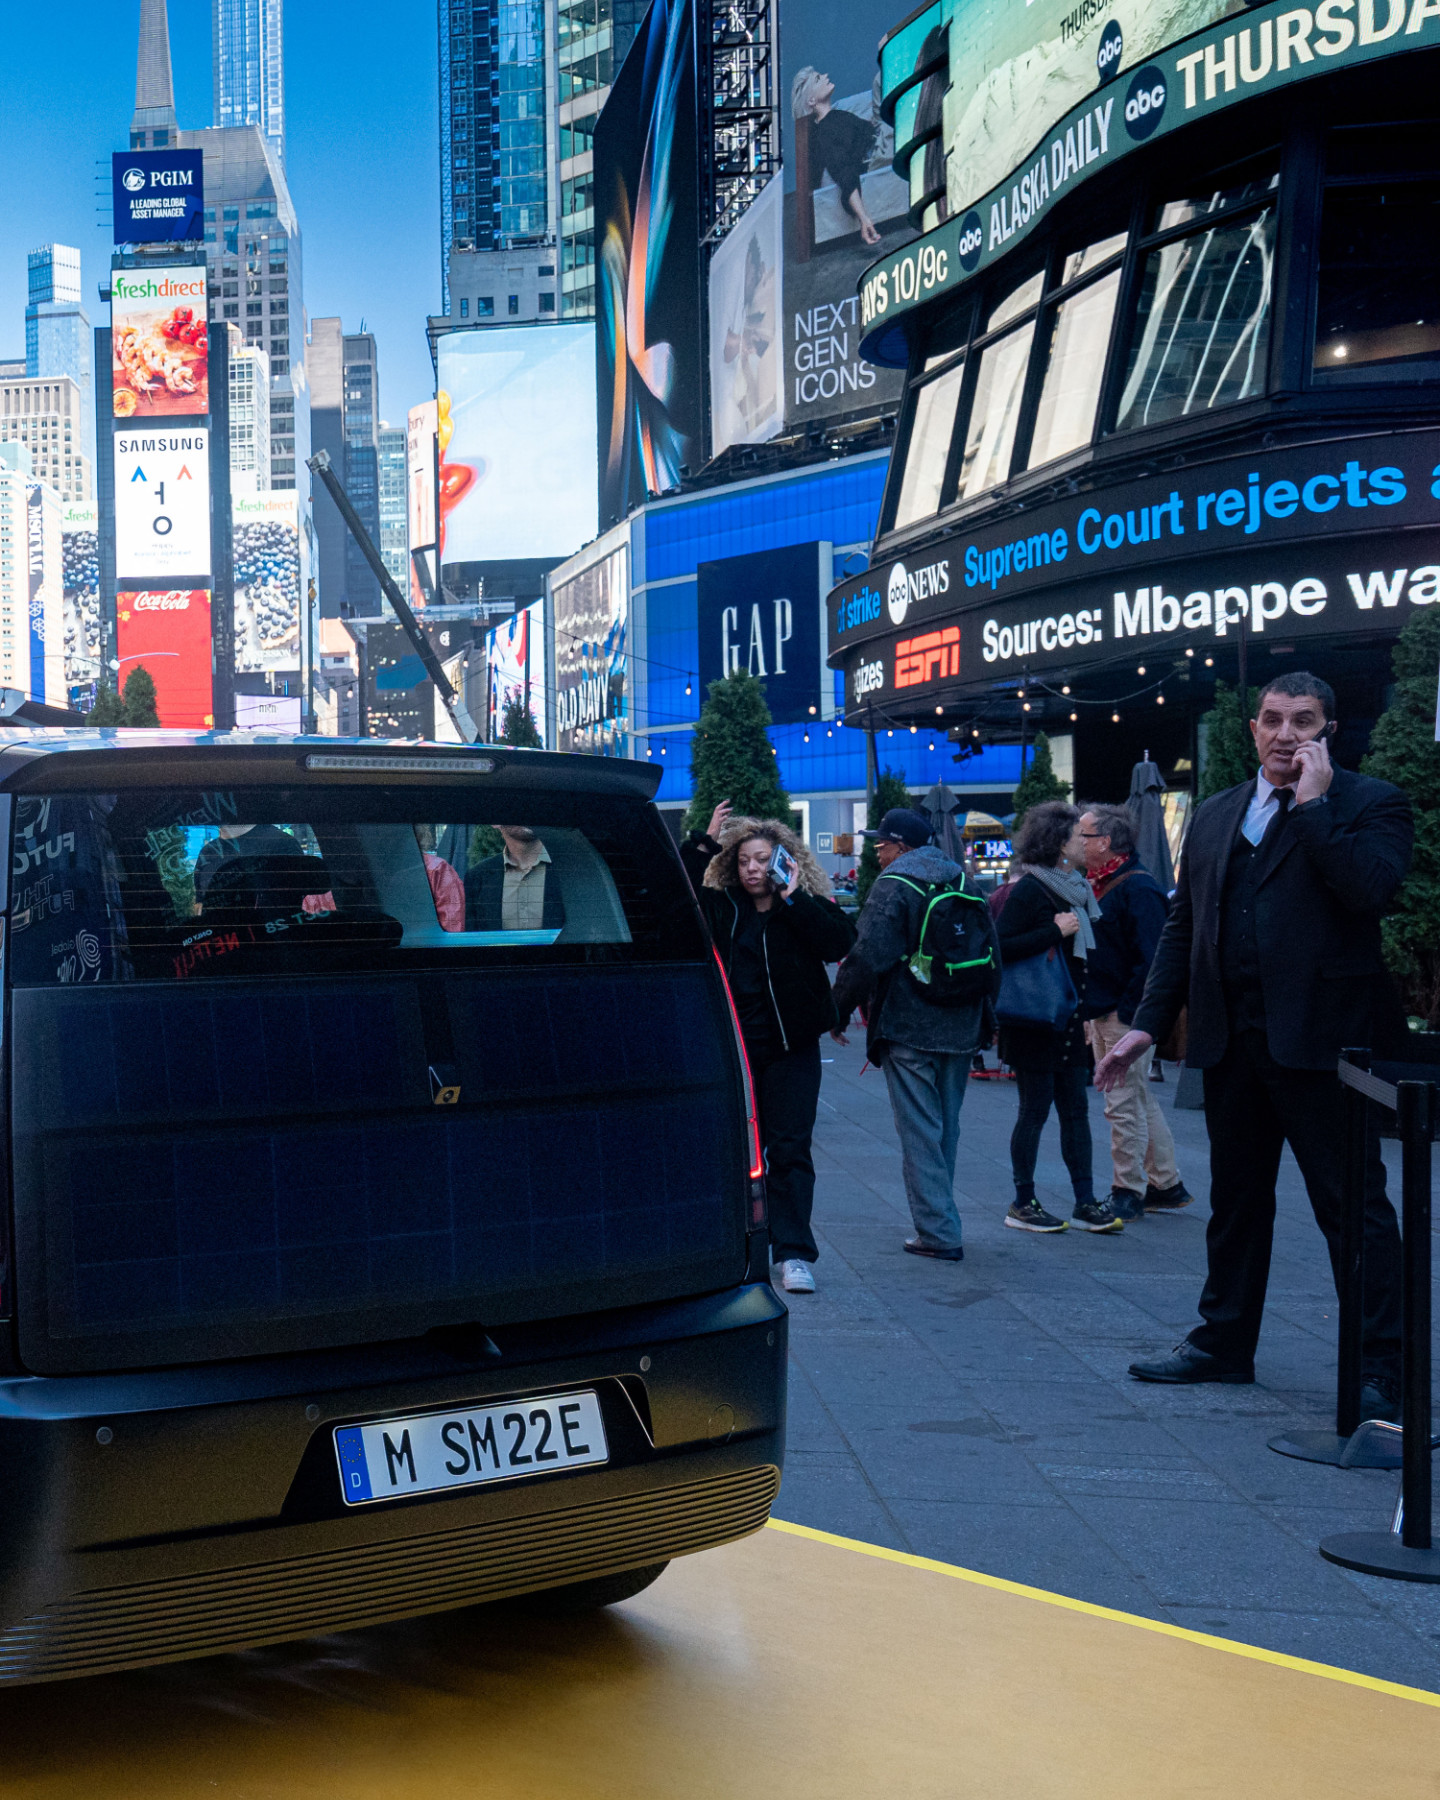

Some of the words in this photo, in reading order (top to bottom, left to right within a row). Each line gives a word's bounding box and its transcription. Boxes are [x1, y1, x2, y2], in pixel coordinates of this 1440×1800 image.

[1097, 35, 1123, 68] abc
[1124, 85, 1166, 122] abc
[150, 170, 194, 187] PGIM
[987, 154, 1050, 252] ALASKA
[1052, 97, 1115, 192] DAILY
[130, 200, 136, 209] A
[136, 199, 162, 209] LEADING
[163, 197, 187, 208] GLOBAL
[132, 209, 152, 219] ASSET
[960, 226, 983, 256] abc
[113, 277, 206, 299] freshdirect
[861, 271, 888, 326] AYS
[891, 245, 948, 304] 10/9c
[795, 297, 859, 341] NEXT
[794, 332, 849, 372] GEN
[795, 364, 877, 405] ICONS
[119, 437, 204, 453] SAMSUNG
[236, 499, 294, 513] freshdirect
[964, 527, 1068, 590] Supreme
[1076, 491, 1185, 555] Court
[1197, 461, 1408, 533] rejects
[907, 560, 949, 604] NEWS
[837, 597, 846, 634] of
[847, 586, 881, 629] strike
[982, 607, 1102, 662] Sources:
[1113, 577, 1328, 638] Mbappe
[722, 598, 793, 680] GAP
[894, 626, 961, 689] ESPN
[558, 686, 578, 732] OLD
[579, 672, 609, 727] NAVY
[853, 658, 884, 704] gizes
[382, 1429, 417, 1486] M
[350, 1472, 362, 1488] D
